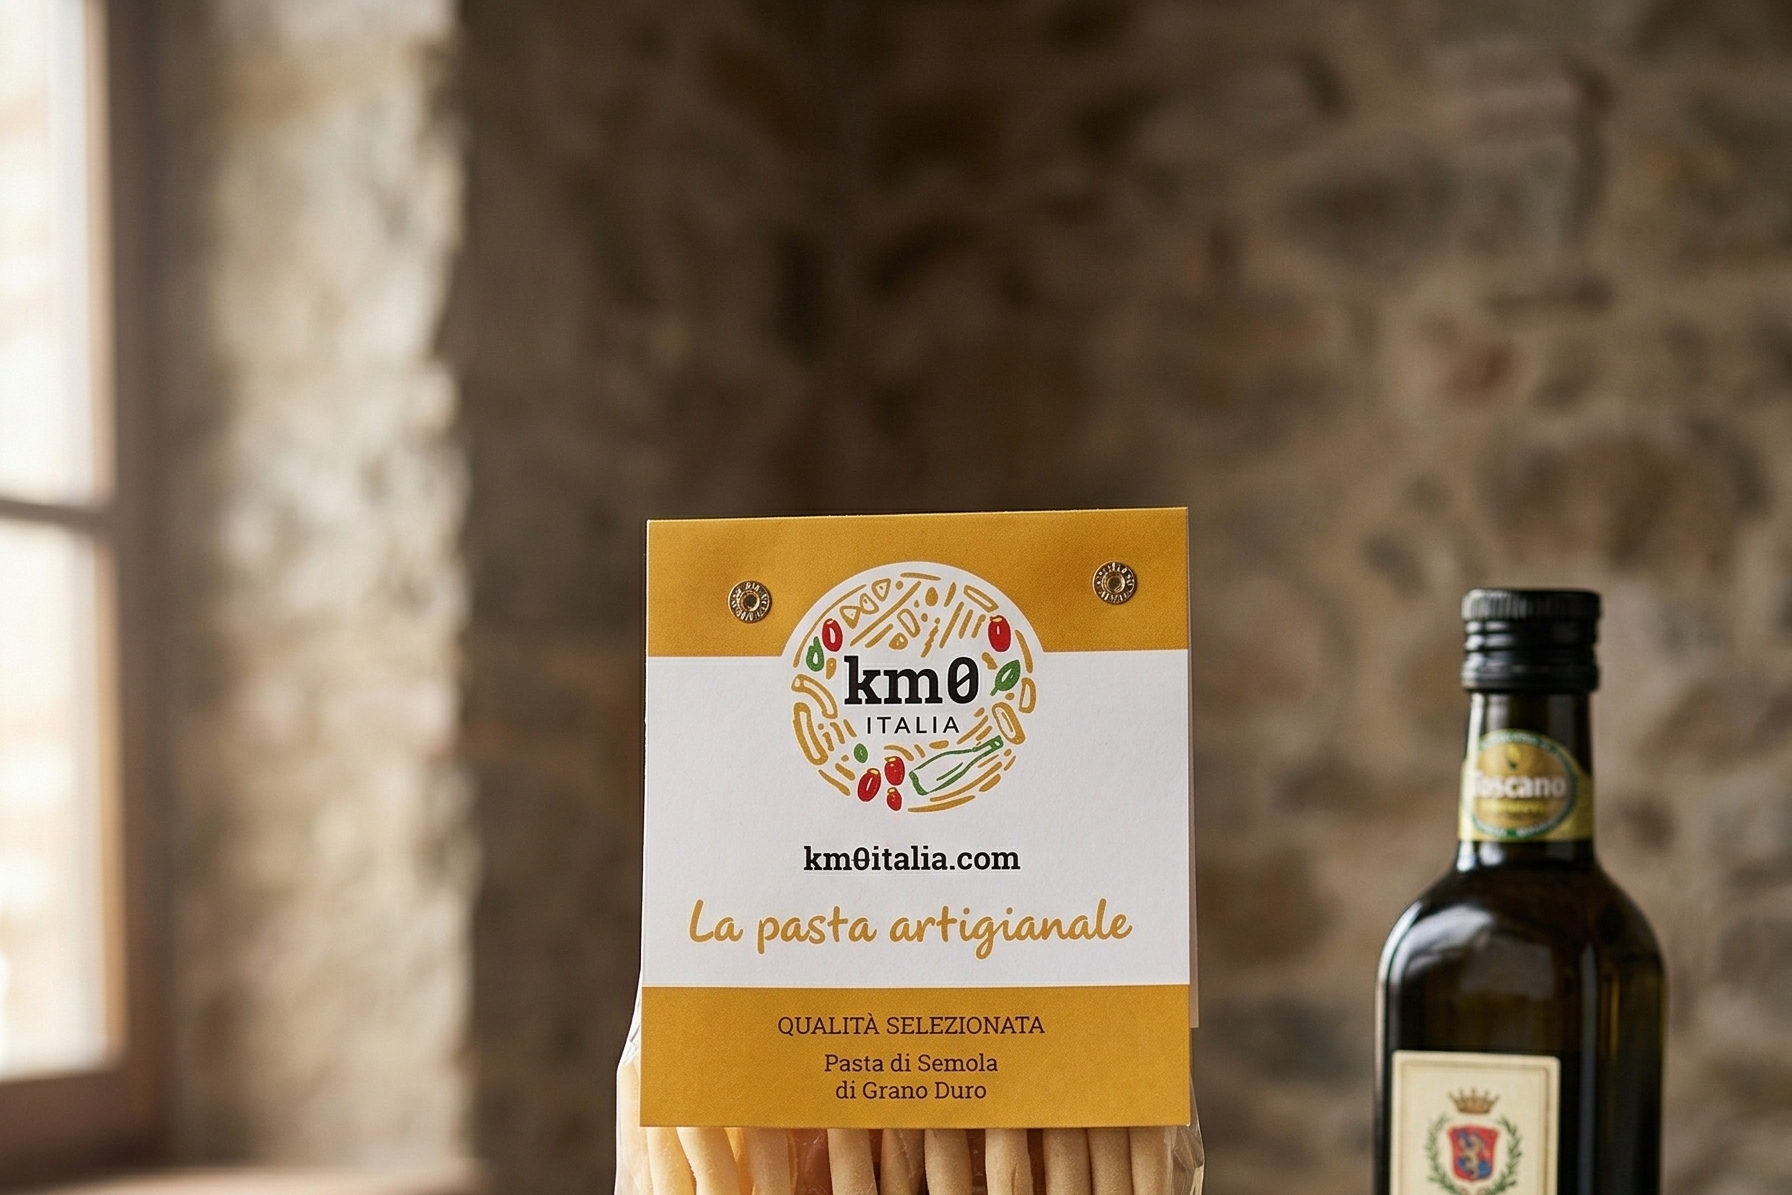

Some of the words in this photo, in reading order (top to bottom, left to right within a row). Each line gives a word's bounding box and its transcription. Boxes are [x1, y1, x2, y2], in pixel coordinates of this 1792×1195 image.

[843, 655, 981, 706] km0
[865, 715, 960, 735] ITALIA
[803, 845, 1021, 871] km0italia.com
[689, 899, 744, 943] La
[757, 906, 876, 954] pasta
[889, 898, 1133, 960] artigianale
[777, 1012, 881, 1037] QUALITÀ
[886, 1015, 1045, 1035] SELEZIONATA
[823, 1053, 885, 1073] Pasta
[890, 1052, 912, 1073] di
[917, 1052, 999, 1073] Semola
[835, 1079, 857, 1100] di
[862, 1081, 928, 1100] Grano
[934, 1081, 987, 1100] Duro
